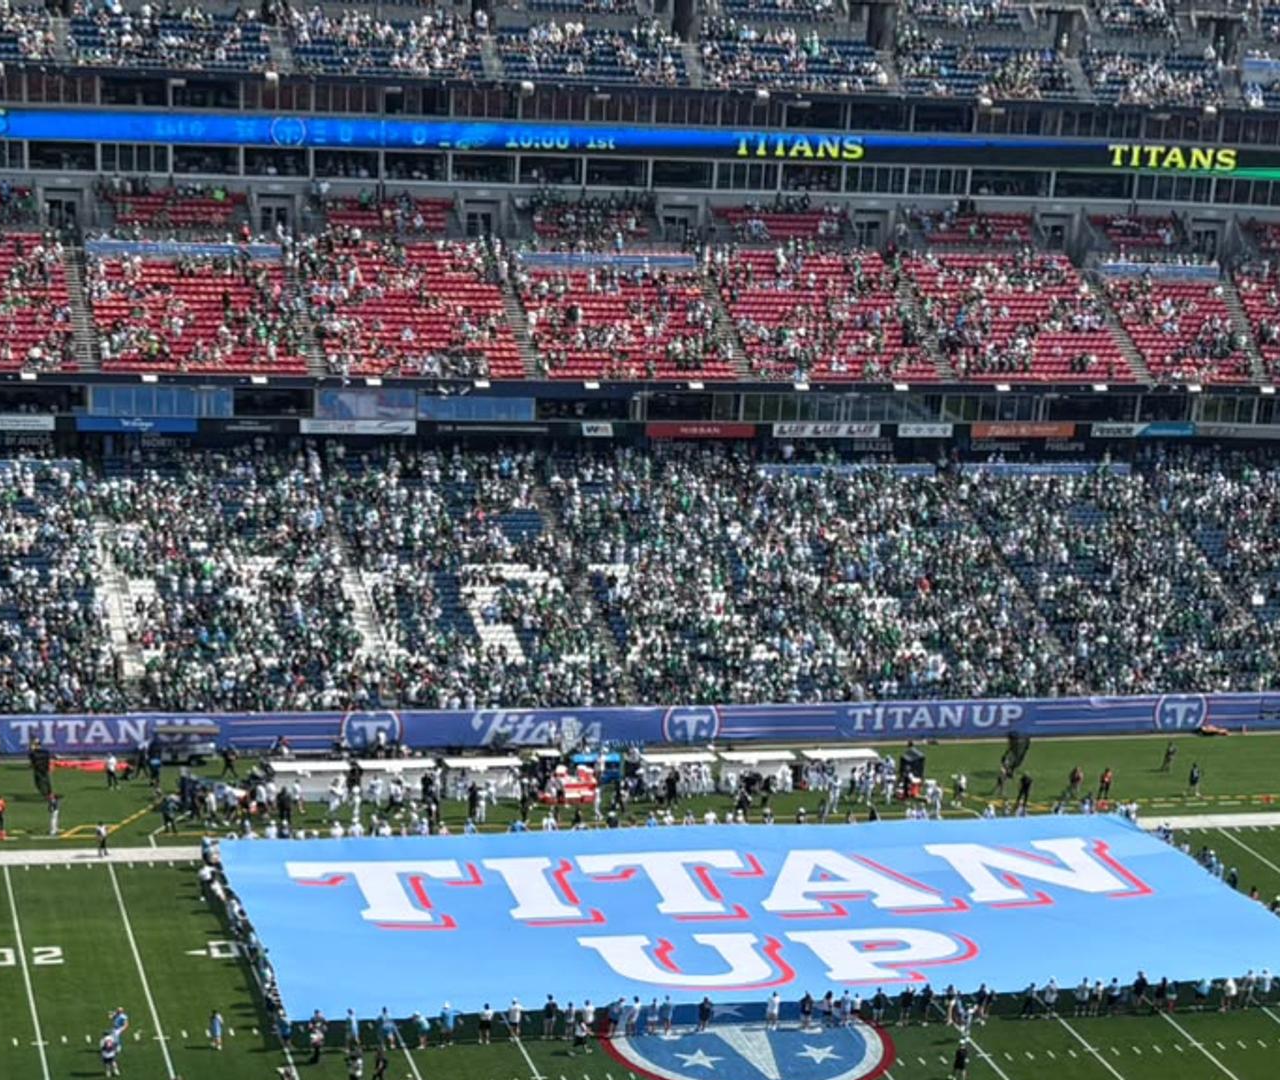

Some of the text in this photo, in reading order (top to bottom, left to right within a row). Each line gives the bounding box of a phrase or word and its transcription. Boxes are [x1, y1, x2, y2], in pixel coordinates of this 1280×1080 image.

[734, 132, 865, 159] TITANS
[1109, 144, 1237, 171] TITANS
[10, 718, 148, 746] TITAN
[847, 704, 1024, 732] TITAN UP
[286, 838, 1152, 928] TITAN
[578, 928, 979, 990] UP
